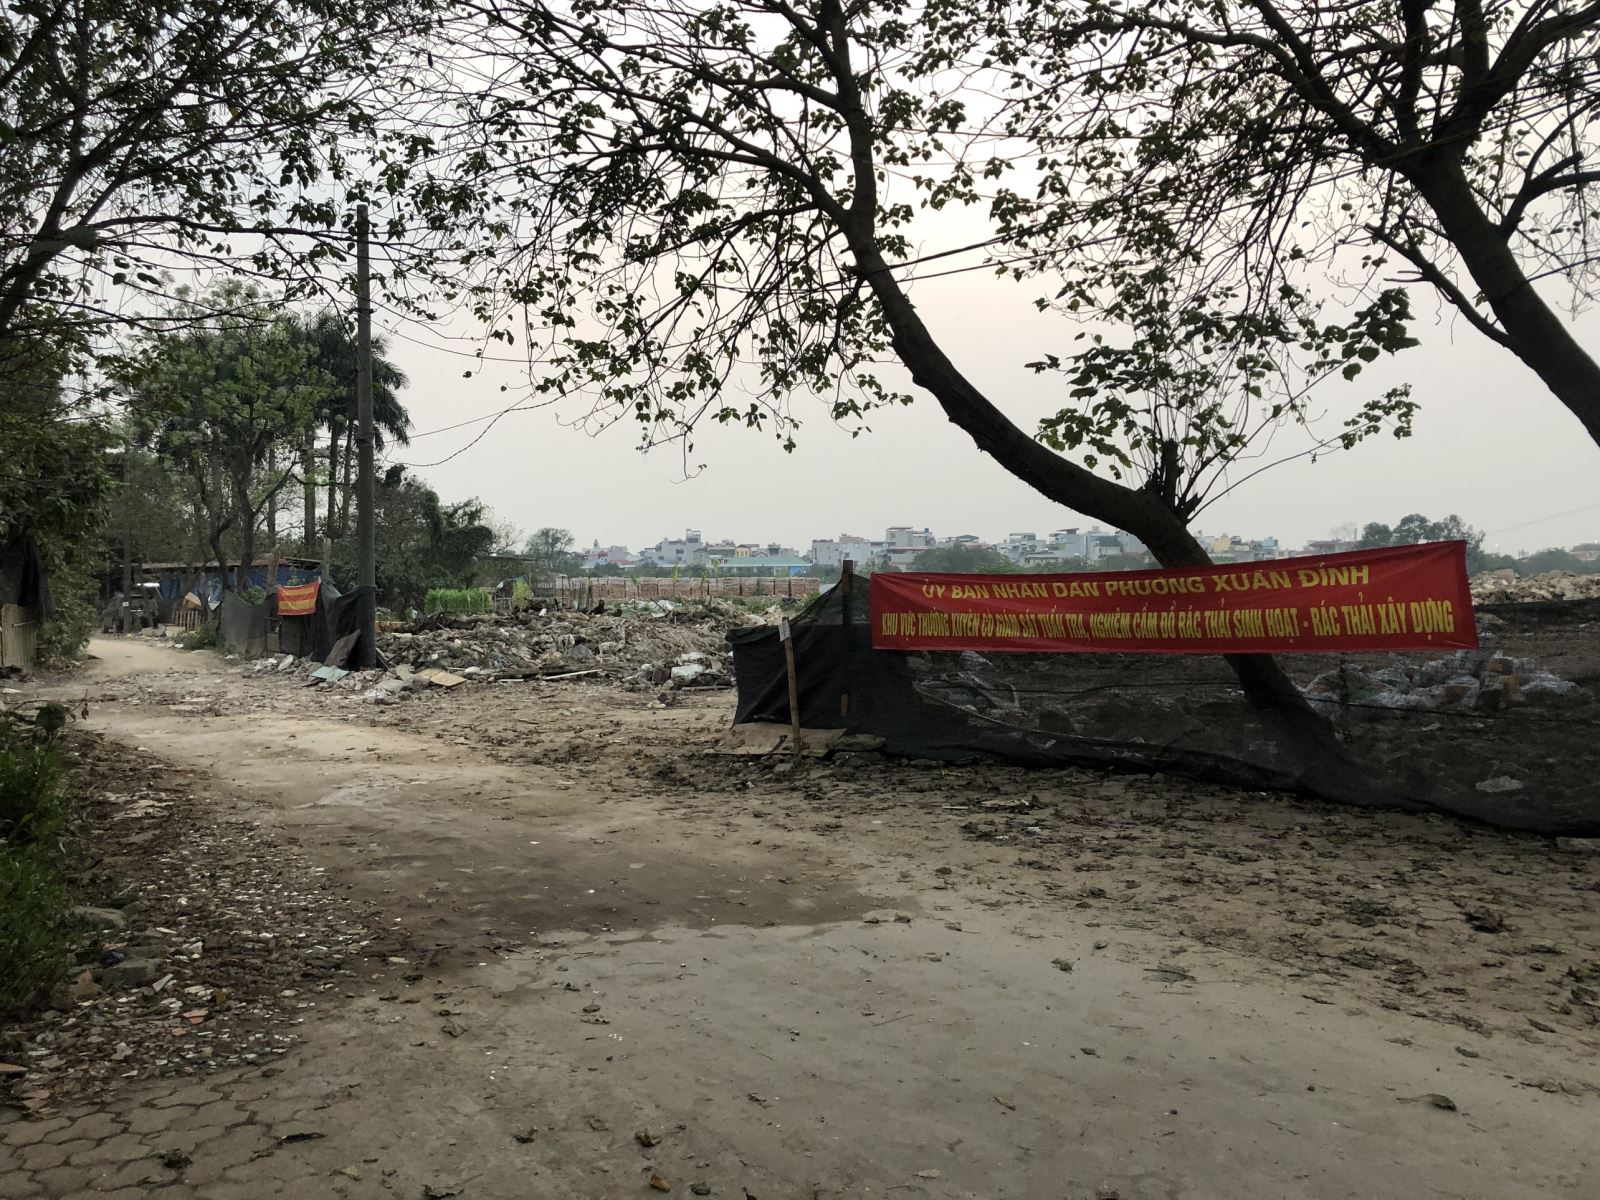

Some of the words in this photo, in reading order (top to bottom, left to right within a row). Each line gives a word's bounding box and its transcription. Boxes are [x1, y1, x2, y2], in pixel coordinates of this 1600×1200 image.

[952, 584, 990, 598] BAN
[991, 581, 1049, 598] NHÂN
[1052, 580, 1100, 597] DÂN
[1211, 570, 1292, 592] XUÂN
[882, 613, 898, 635] KHU
[900, 611, 916, 640] VỰC
[918, 606, 950, 636] THƯỜNG
[952, 608, 980, 637] XUYÊN
[995, 608, 1020, 637] GIÁM
[1019, 608, 1040, 637] SÁT
[1090, 607, 1132, 638] NGHIÊM
[1133, 602, 1159, 638] CẤM
[1160, 600, 1176, 638] ĐỔ
[1178, 604, 1202, 638] RÁC
[1204, 598, 1233, 638] THẢI
[1233, 609, 1265, 638] SINH
[1265, 608, 1300, 642] HOẠT
[1310, 600, 1341, 636] RÁC
[1340, 592, 1377, 635] THẢI
[1376, 596, 1408, 634] XÂY
[1410, 597, 1455, 640] DỰNG
